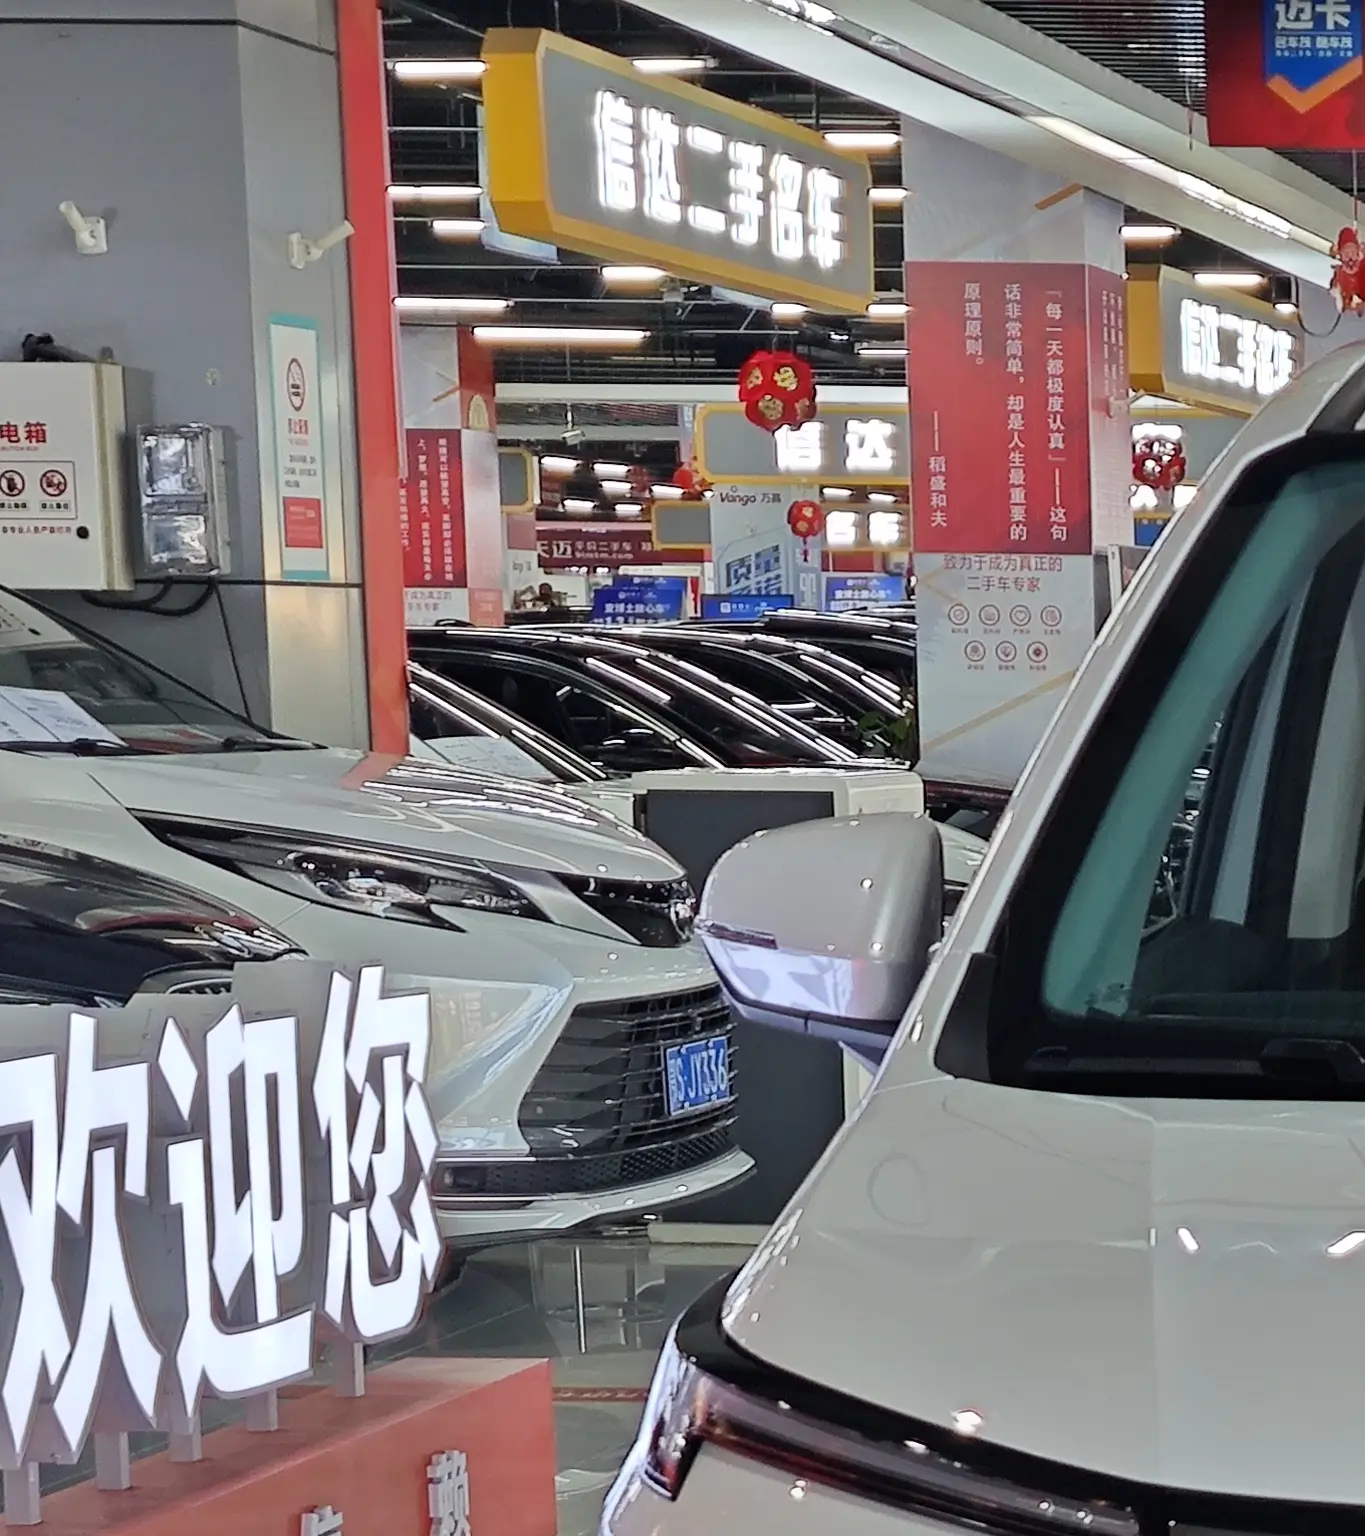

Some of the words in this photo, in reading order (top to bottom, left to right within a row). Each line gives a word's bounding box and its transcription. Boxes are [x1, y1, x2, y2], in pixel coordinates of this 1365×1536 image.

[594, 88, 848, 272] 信达二手名车
[943, 554, 1063, 572] 致力于成为真正的
[967, 576, 1041, 592] 二手车专家
[0, 963, 447, 1466] 欢迎您
